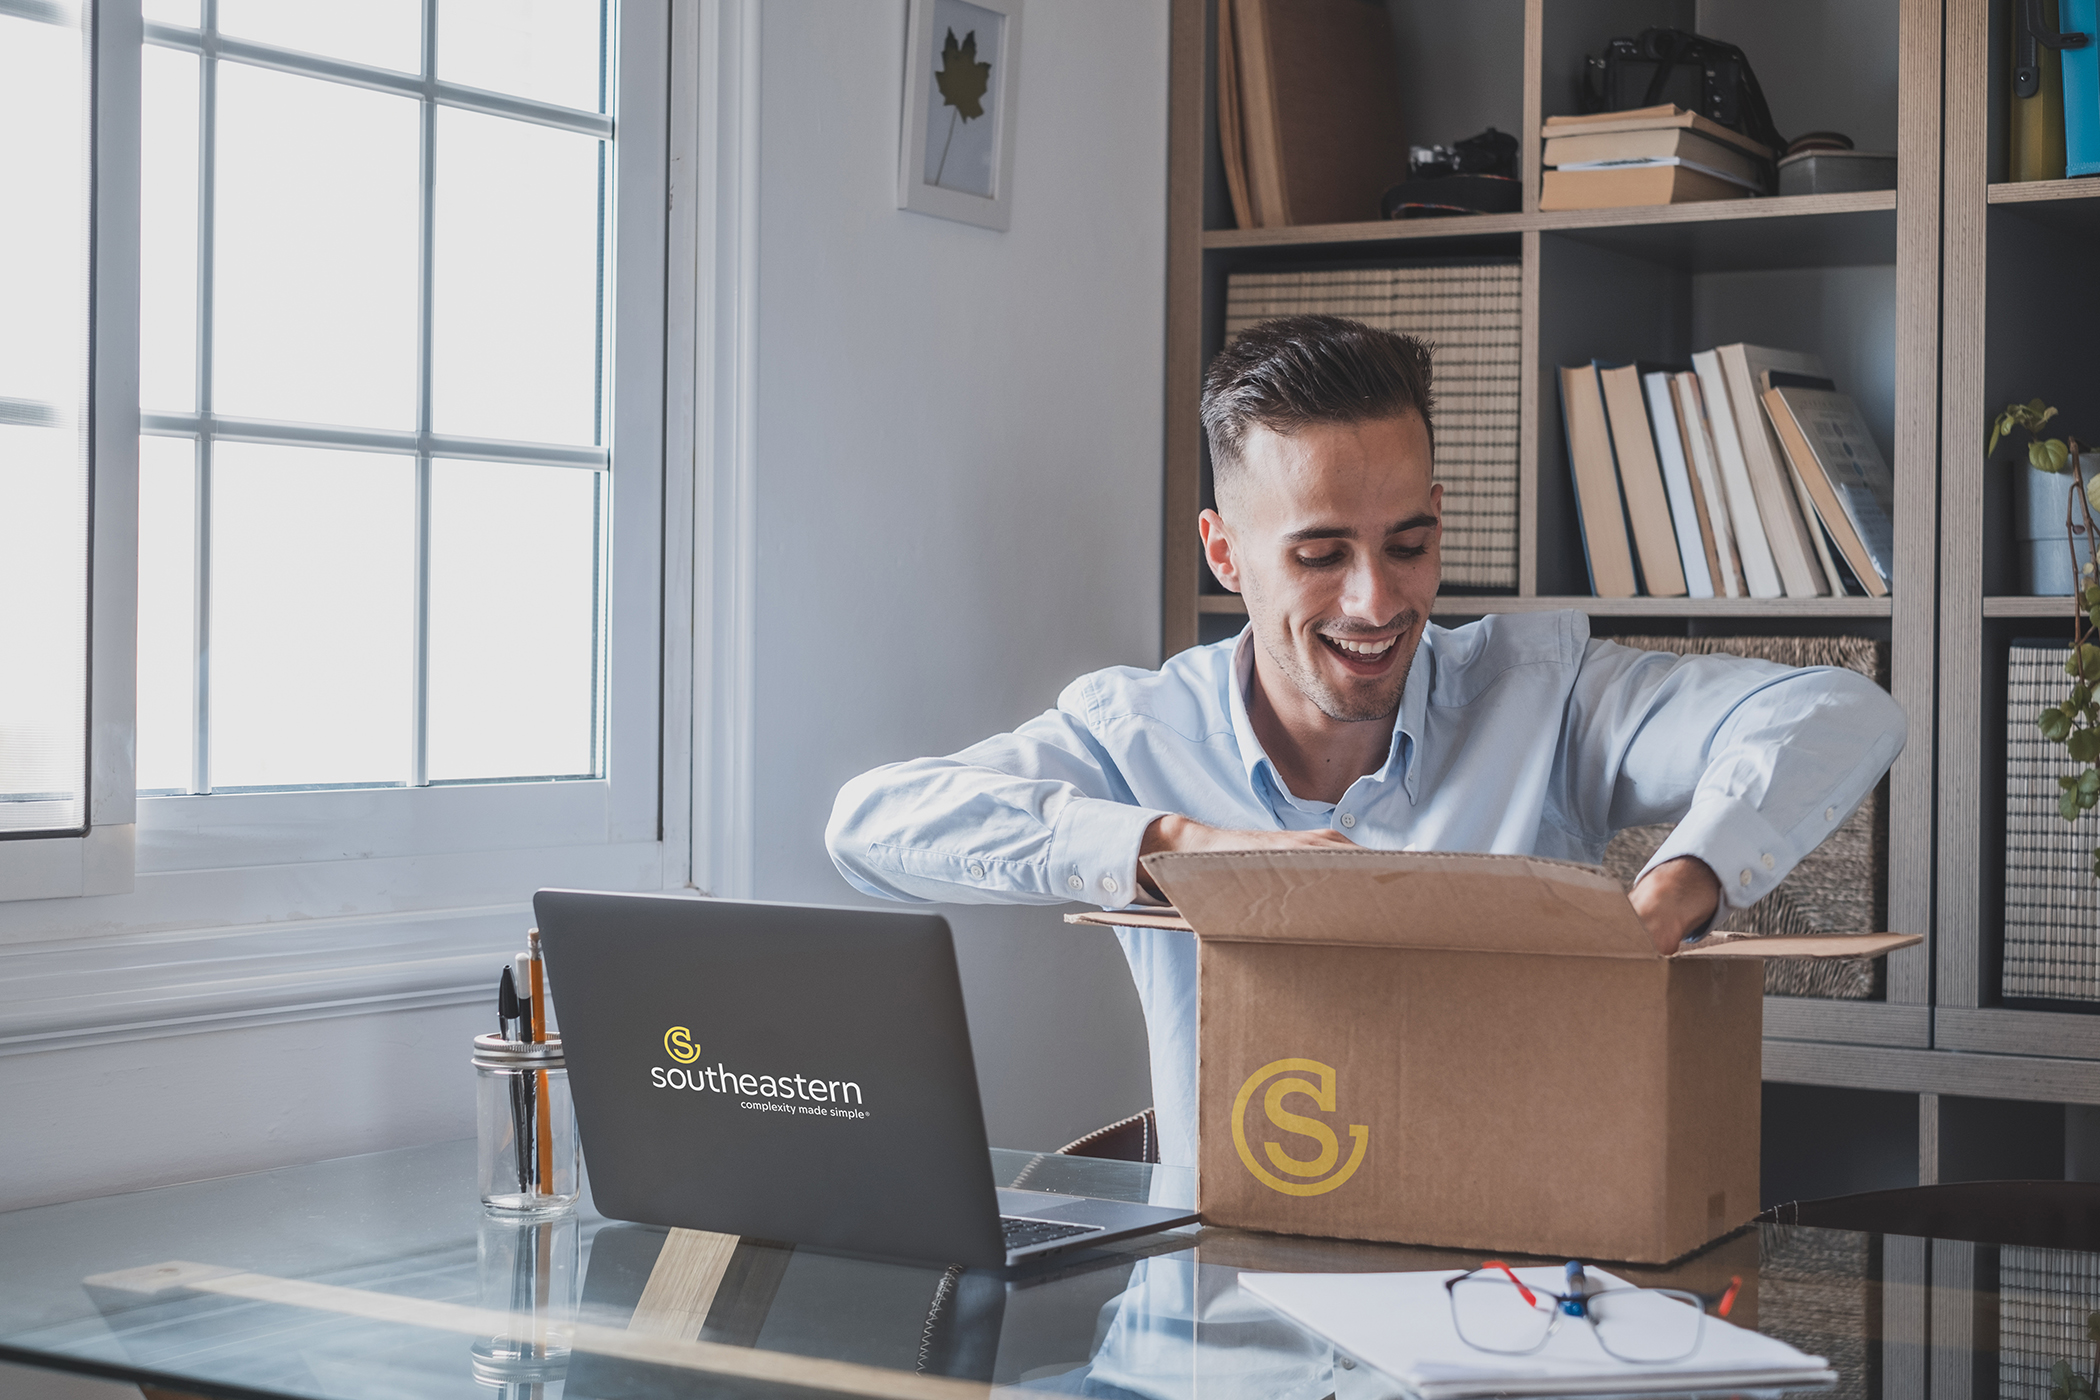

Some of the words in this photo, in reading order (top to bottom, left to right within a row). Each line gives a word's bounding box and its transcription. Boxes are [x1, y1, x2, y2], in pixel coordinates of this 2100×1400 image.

[650, 1062, 863, 1105] southeastern
[740, 1101, 796, 1116] complexity
[798, 1105, 828, 1116] made
